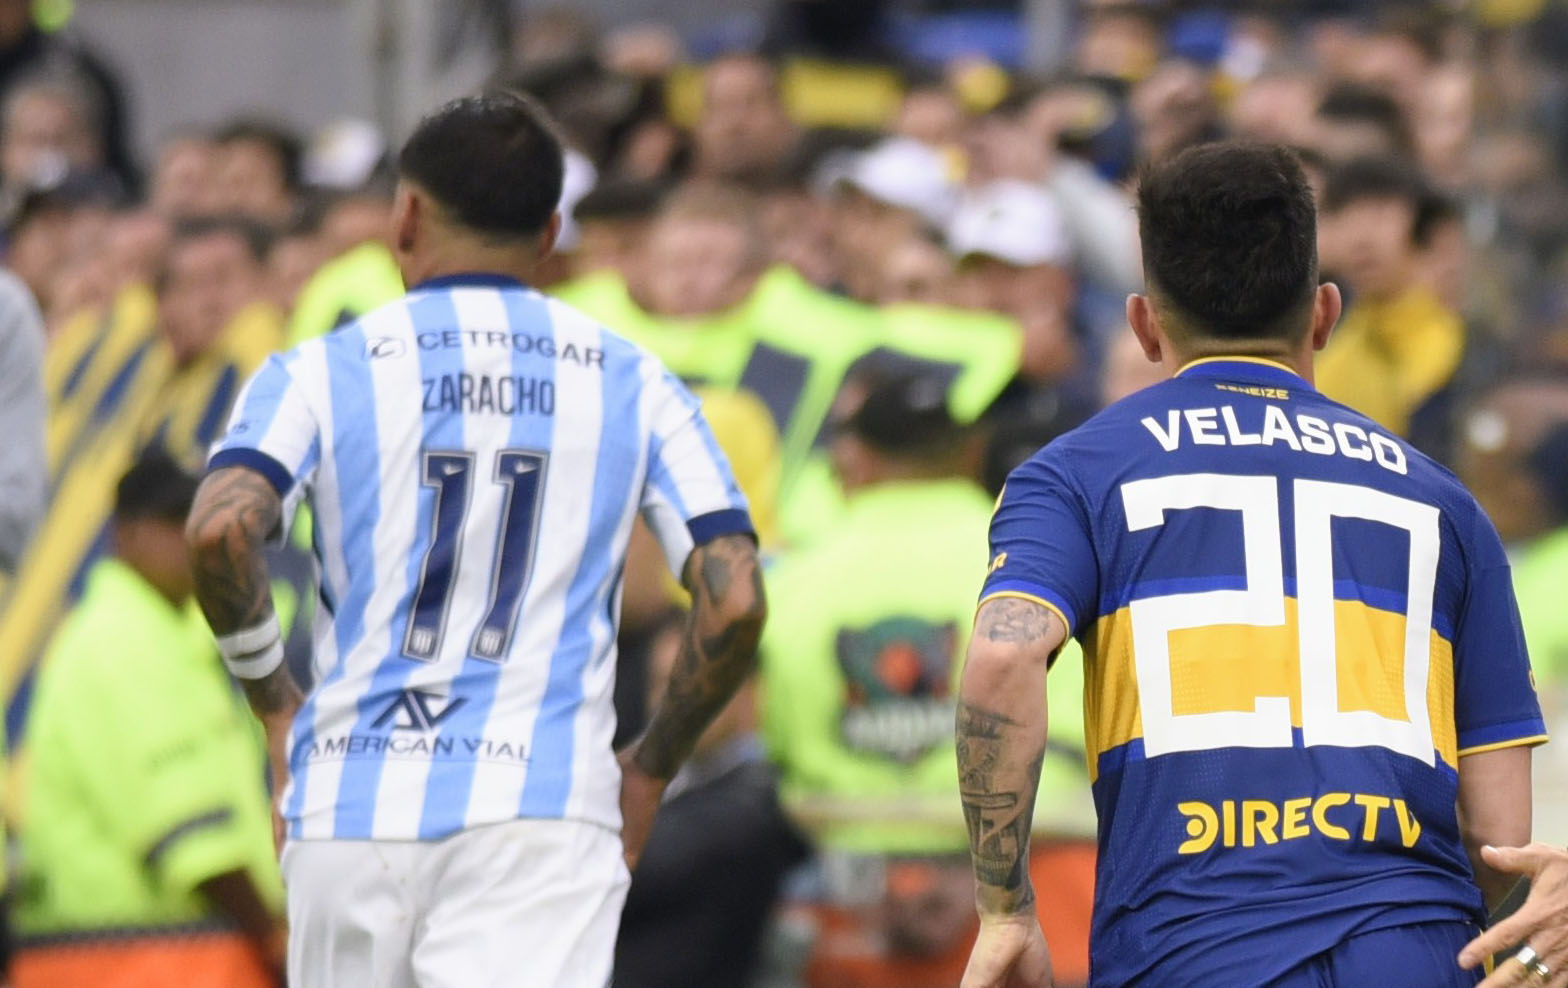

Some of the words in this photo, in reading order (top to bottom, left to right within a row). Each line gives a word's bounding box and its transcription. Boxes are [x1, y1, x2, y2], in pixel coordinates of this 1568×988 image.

[416, 330, 607, 371] CETROGAR
[422, 371, 555, 417] ZARACHO
[1141, 405, 1409, 475] VELASCO
[402, 447, 550, 665] 11
[1121, 472, 1442, 769] 20
[309, 734, 454, 758] AMERICAN
[463, 737, 533, 763] VIAL
[1177, 792, 1422, 855] DIRECTV
